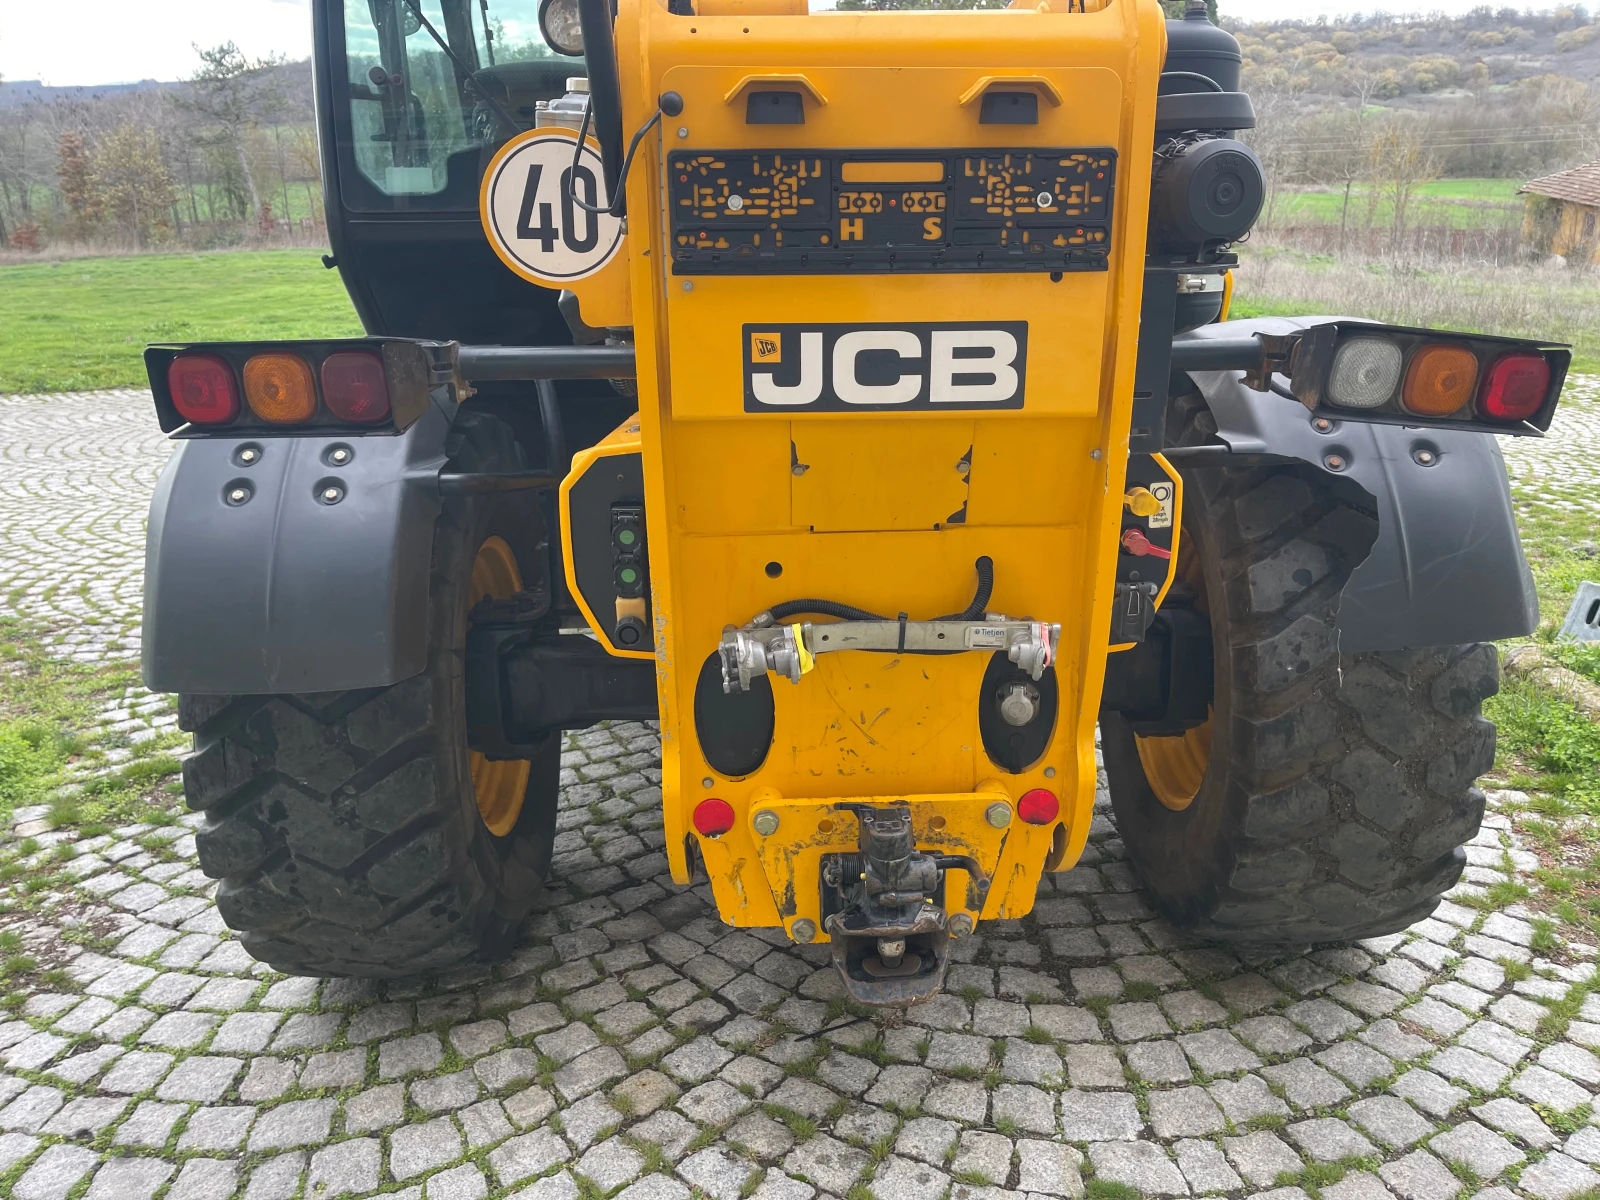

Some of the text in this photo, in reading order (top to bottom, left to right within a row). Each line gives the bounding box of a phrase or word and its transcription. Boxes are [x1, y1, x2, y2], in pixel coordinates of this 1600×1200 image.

[516, 163, 599, 253] 40
[840, 216, 943, 241] H S
[758, 340, 776, 355] JCB
[751, 330, 1019, 405] JCB
[981, 628, 1004, 637] Tietjen
